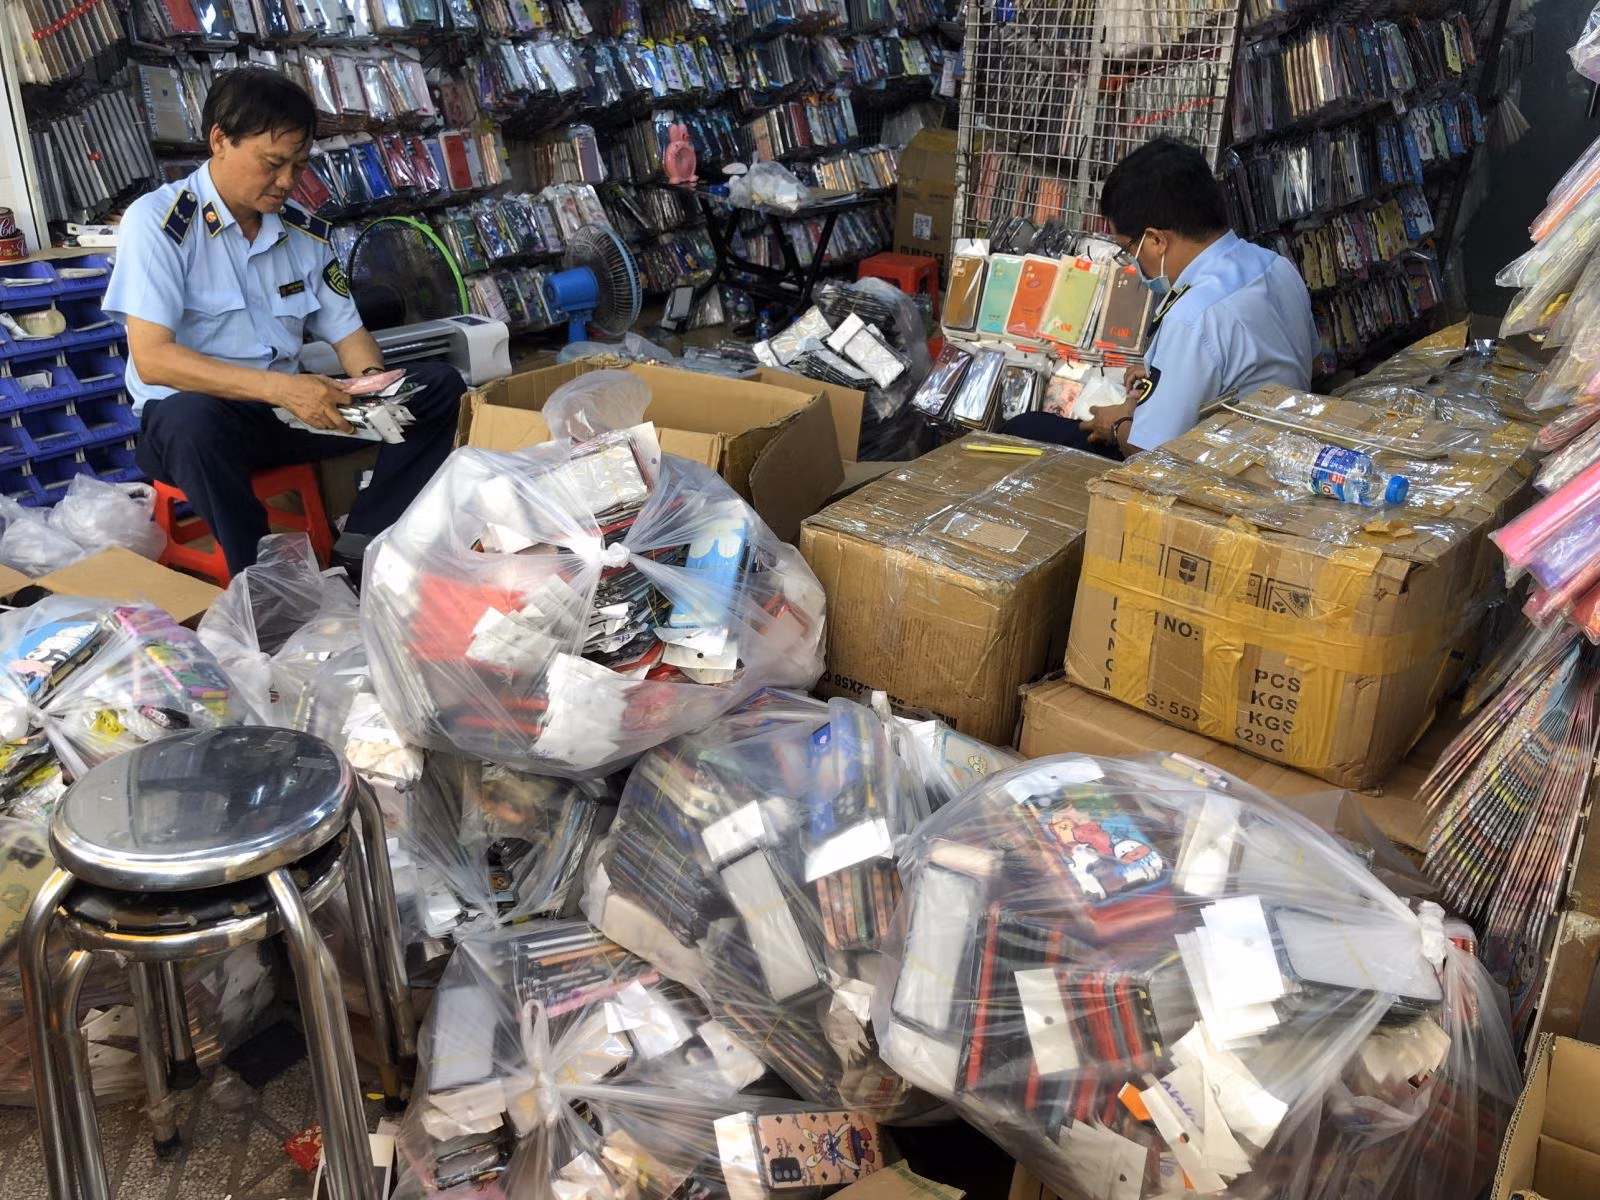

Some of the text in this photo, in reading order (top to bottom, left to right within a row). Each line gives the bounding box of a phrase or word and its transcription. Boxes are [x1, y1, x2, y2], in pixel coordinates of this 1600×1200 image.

[1163, 615, 1200, 641] NO:
[1254, 668, 1301, 693] PCS
[1250, 689, 1298, 715] KGS
[1248, 710, 1294, 735] KGS
